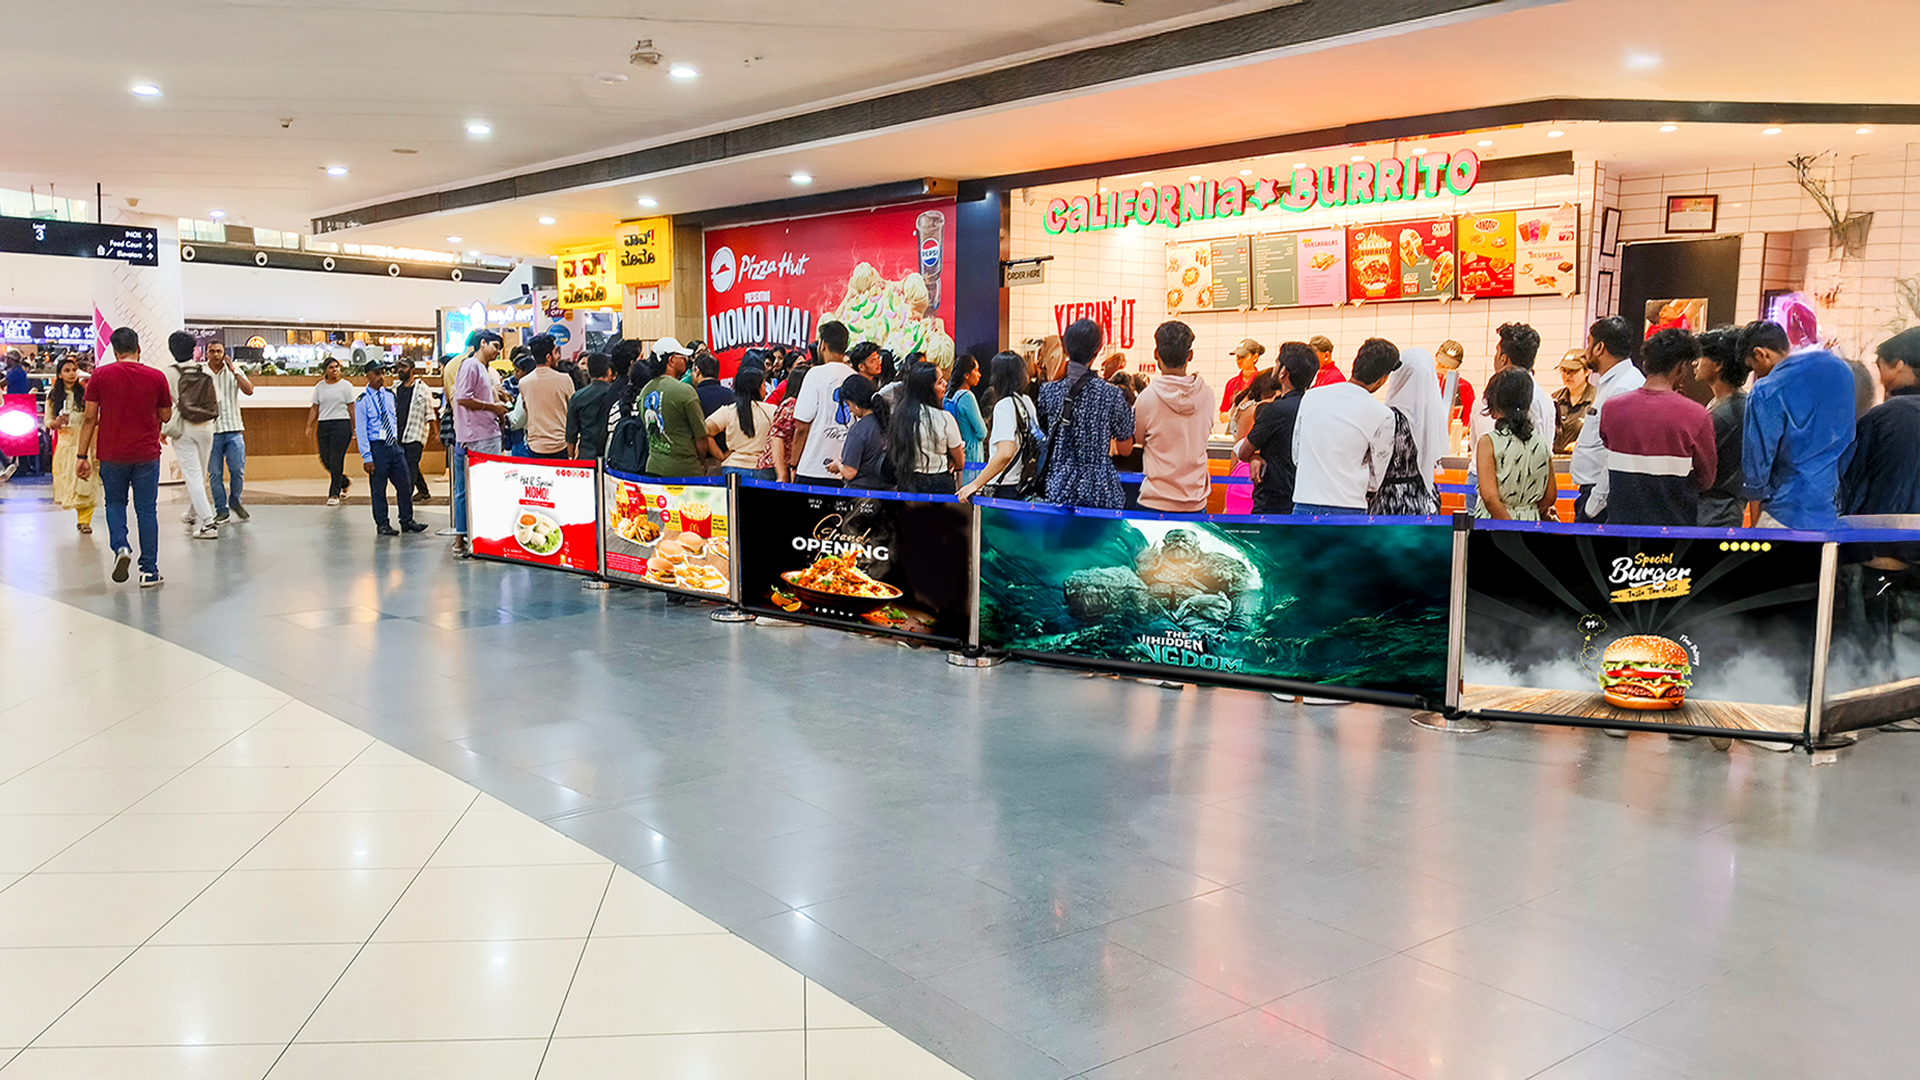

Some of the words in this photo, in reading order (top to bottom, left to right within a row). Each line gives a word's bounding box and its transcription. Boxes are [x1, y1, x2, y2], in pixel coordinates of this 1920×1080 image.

[1044, 177, 1246, 235] CALIFORNIA
[1280, 148, 1480, 212] BURRITO
[35, 229, 45, 241] 3
[125, 231, 142, 239] INOX
[110, 239, 125, 248] Food
[125, 241, 142, 249] Court
[921, 249, 939, 257] PEPSI
[738, 254, 777, 283] Pizza
[1007, 270, 1026, 281] ORDER
[1026, 268, 1041, 279] HERE
[1, 320, 32, 331] TACO
[710, 304, 766, 352] MOMO
[4, 329, 31, 339] BELL
[524, 485, 549, 500] MOMO!
[813, 513, 871, 549] Grand
[792, 536, 889, 561] OPENING
[1634, 552, 1674, 567] Special
[1608, 556, 1692, 590] Burger
[1165, 630, 1189, 639] THE
[1151, 636, 1204, 652] HIDDEN
